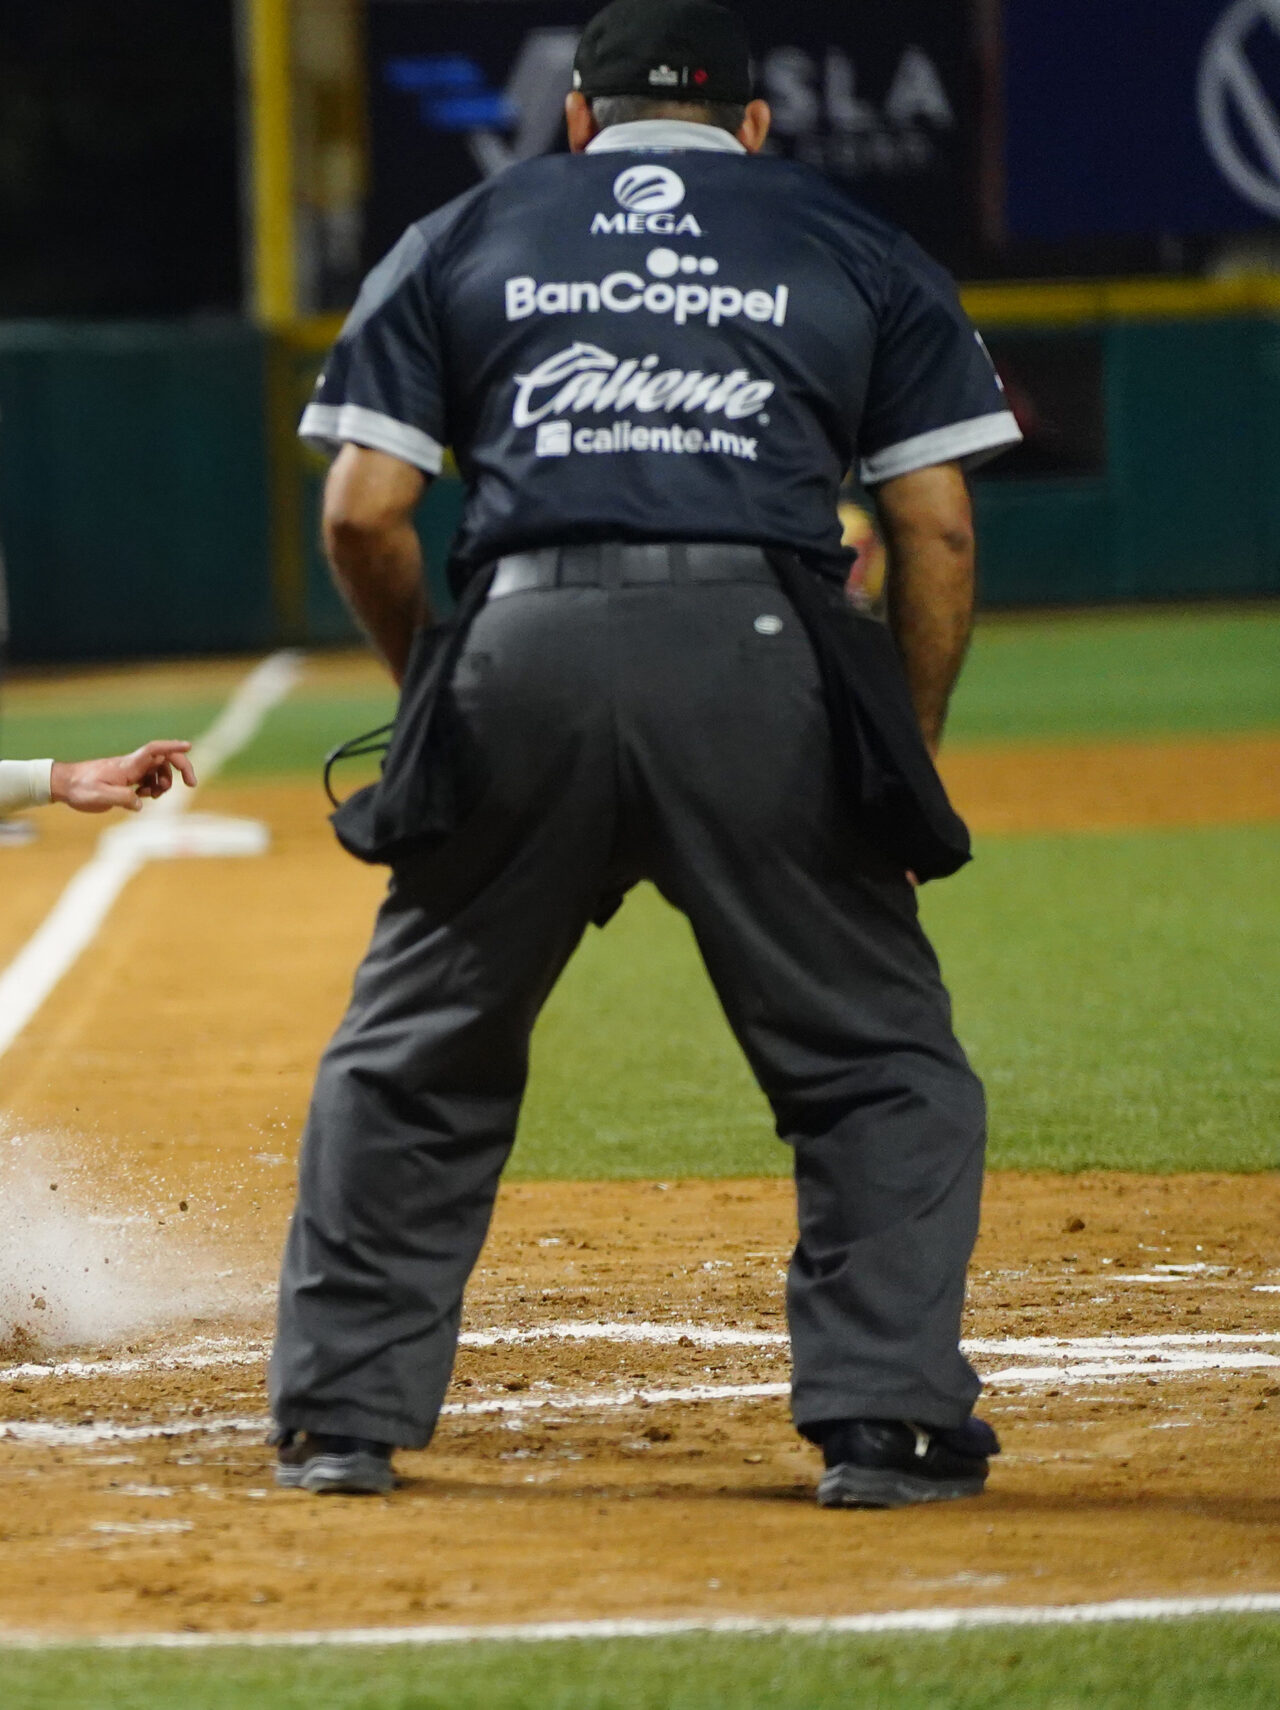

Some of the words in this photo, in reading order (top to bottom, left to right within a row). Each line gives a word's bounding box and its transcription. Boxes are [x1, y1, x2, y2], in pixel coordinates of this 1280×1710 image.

[589, 212, 703, 237] MEGA
[504, 269, 789, 328] BanCoppel
[512, 340, 776, 429] Caliente
[573, 419, 758, 462] caliente.mx
